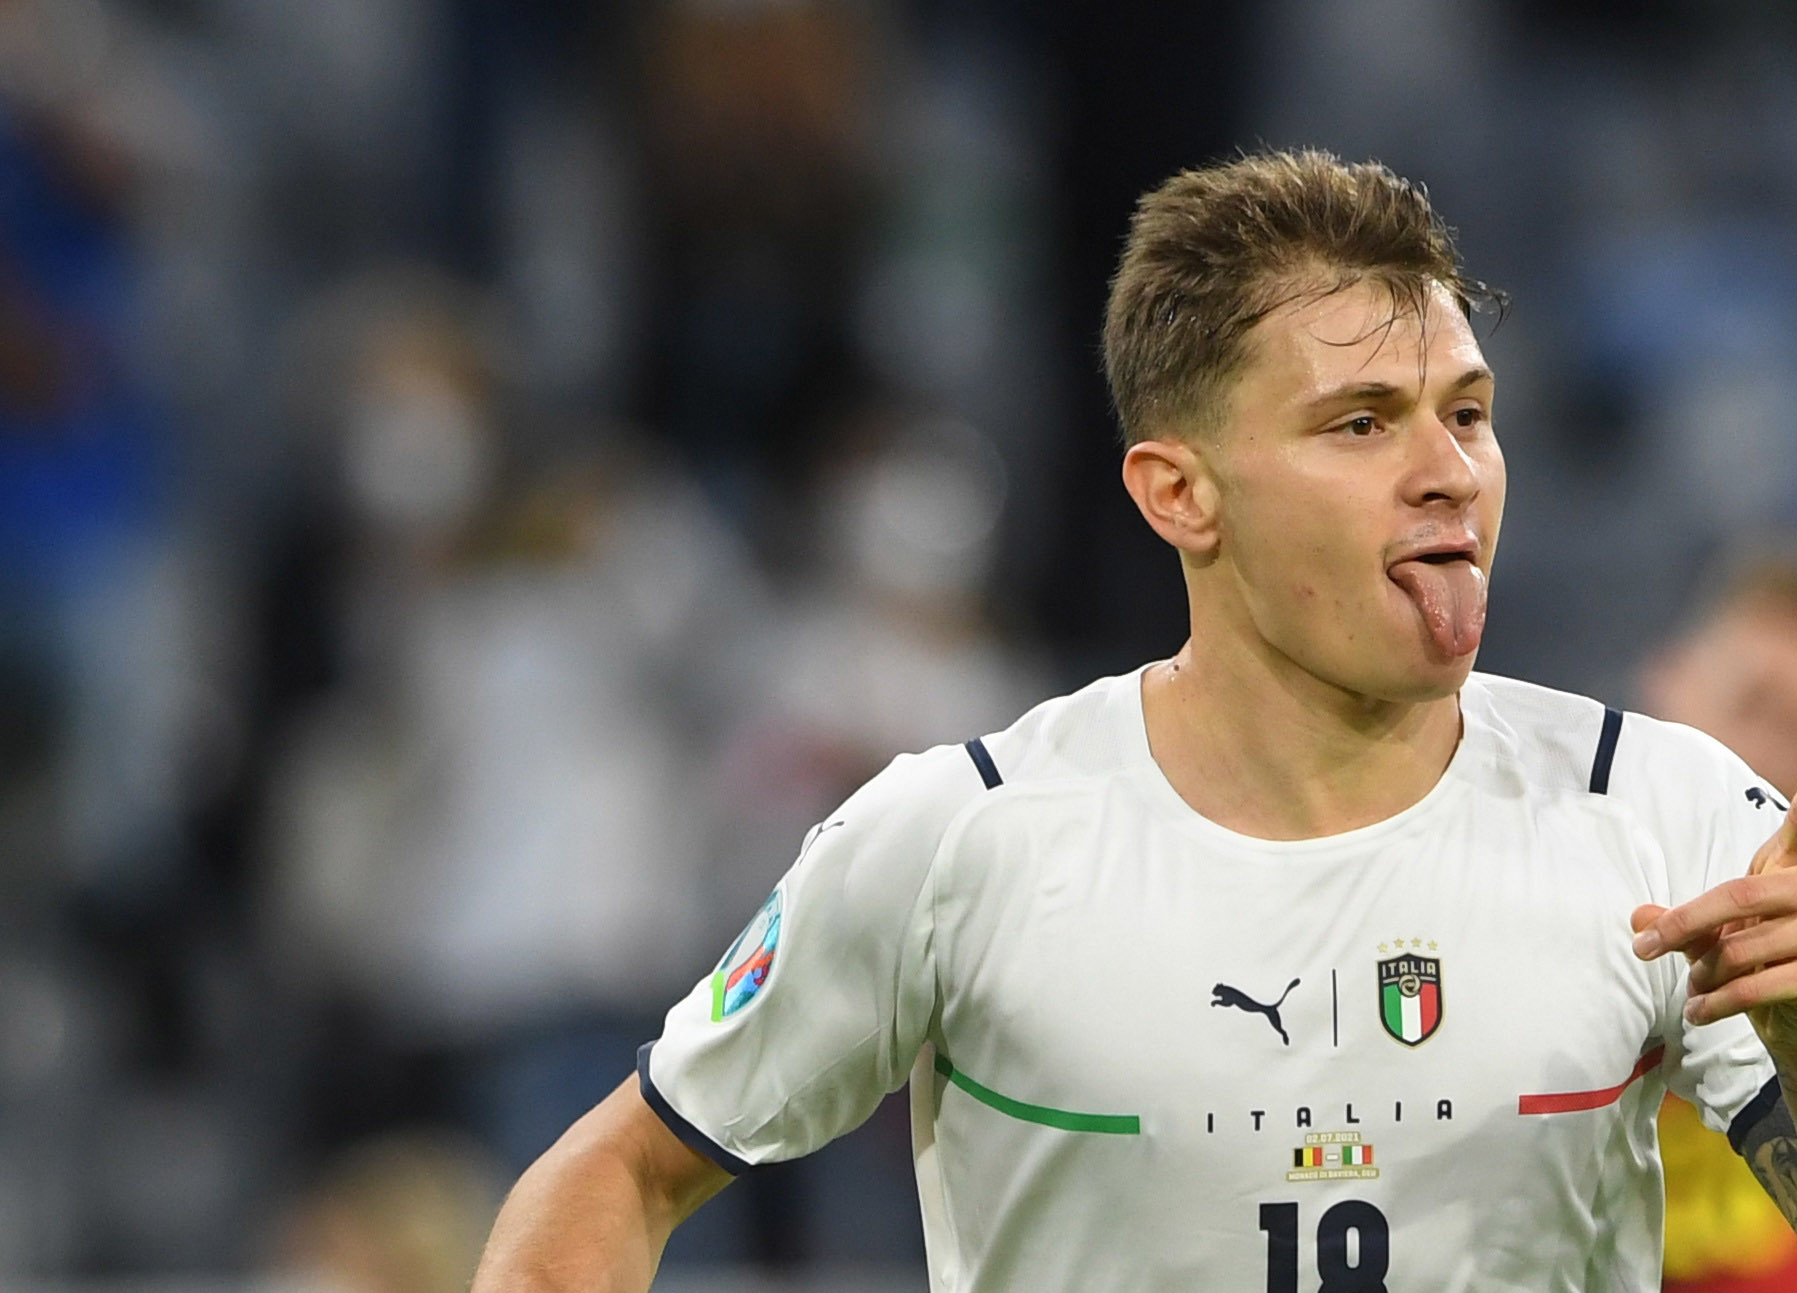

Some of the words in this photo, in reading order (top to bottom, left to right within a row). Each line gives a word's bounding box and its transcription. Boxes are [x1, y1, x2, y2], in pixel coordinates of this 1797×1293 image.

[1382, 960, 1436, 977] ITALIA
[1206, 1099, 1453, 1133] ITALIA
[1305, 1132, 1360, 1144] 02.07.2021
